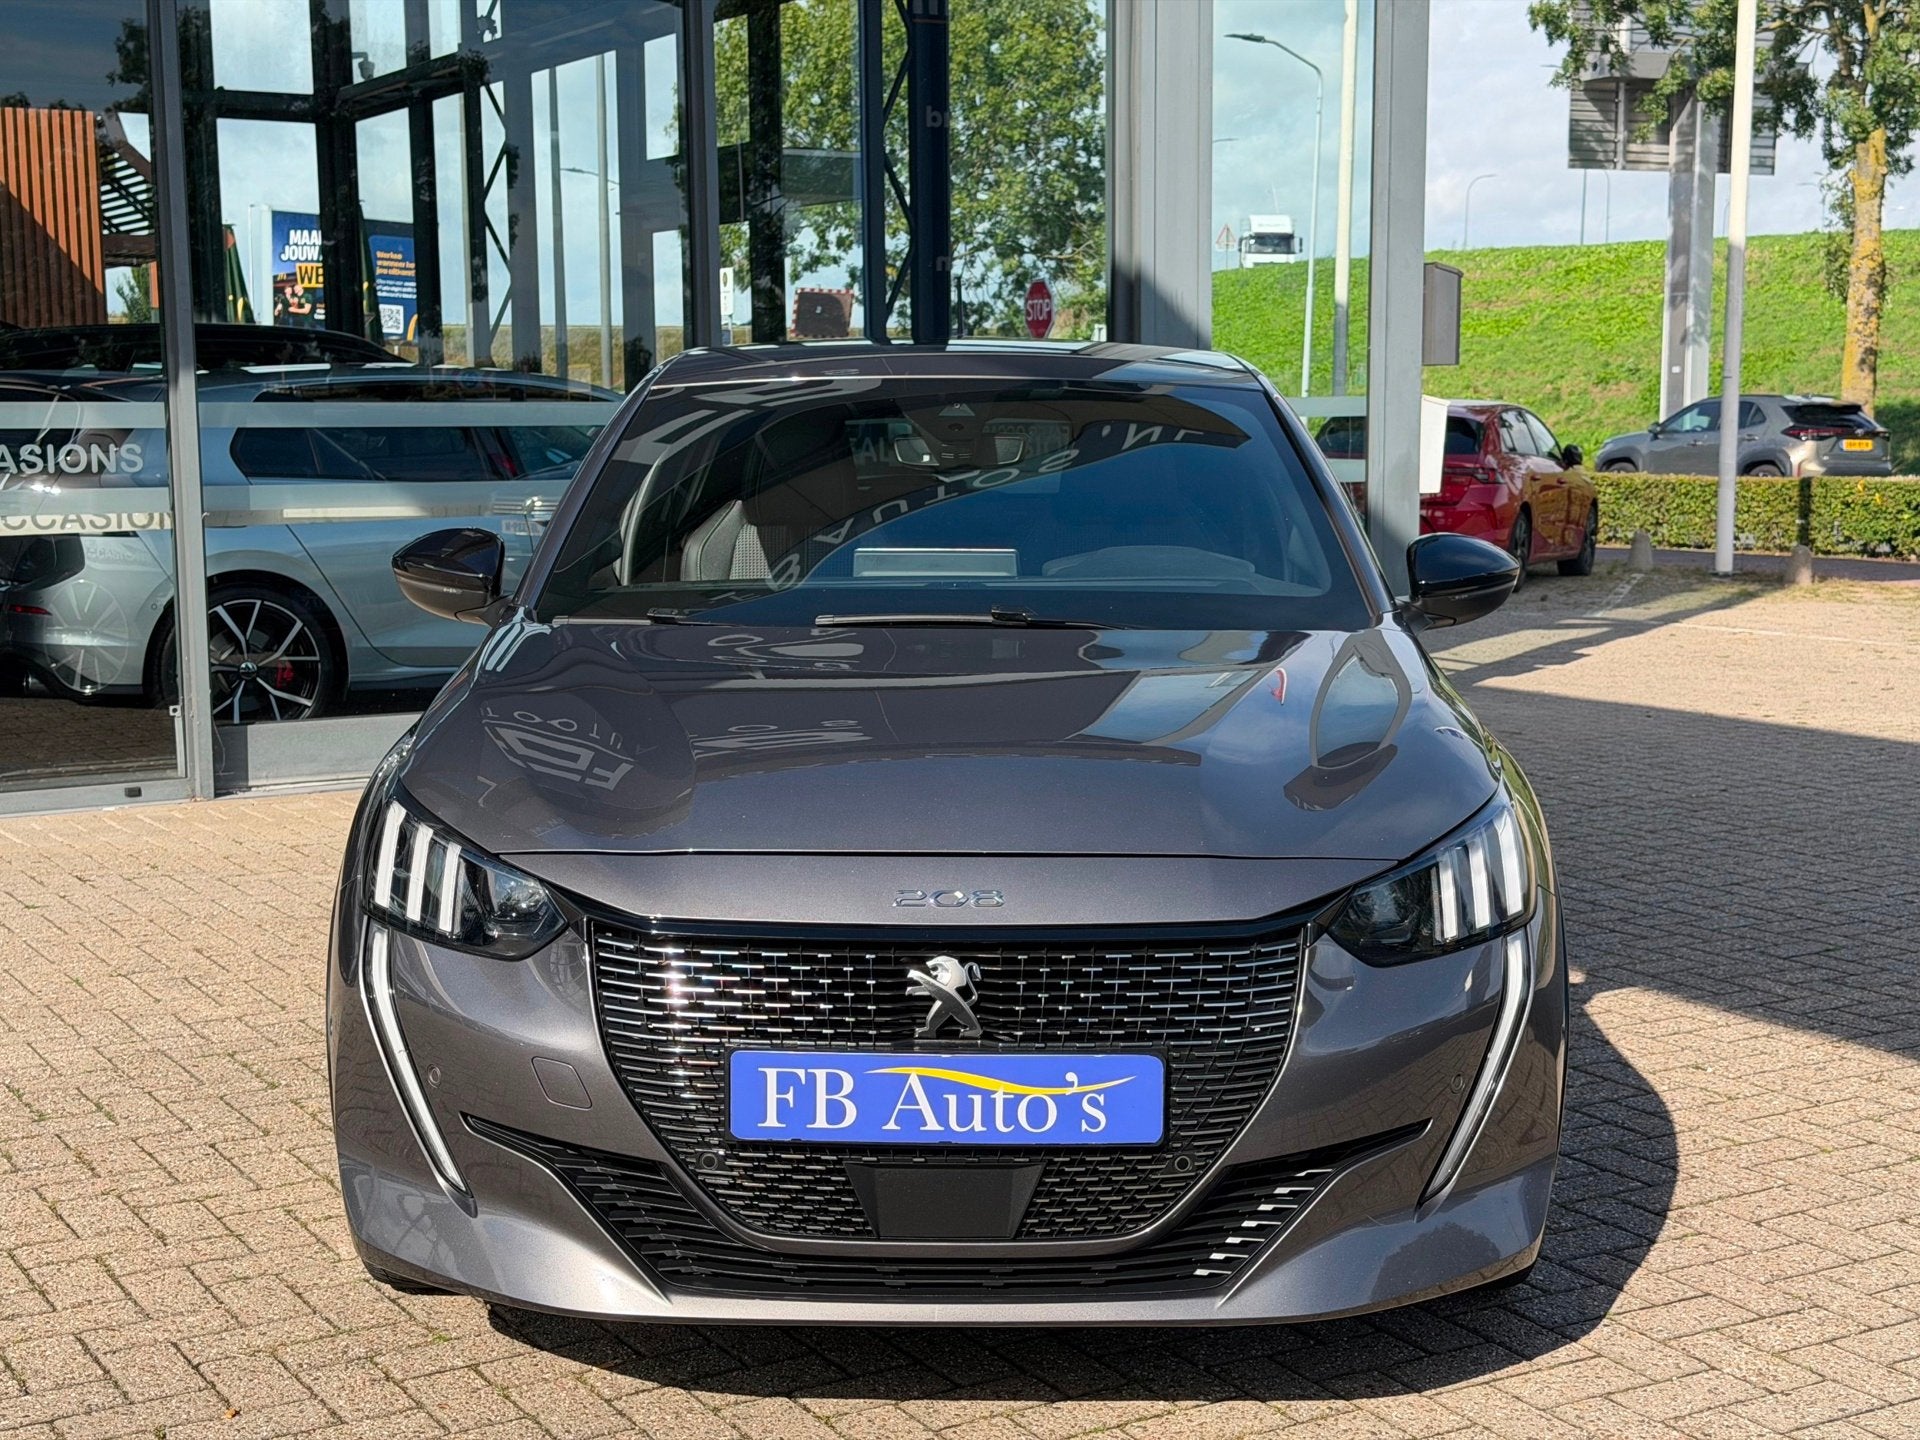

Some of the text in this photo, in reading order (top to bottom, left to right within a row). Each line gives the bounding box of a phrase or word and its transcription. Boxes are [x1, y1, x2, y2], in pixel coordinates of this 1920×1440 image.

[280, 245, 320, 261] JOUW
[1027, 299, 1051, 321] STOP
[891, 889, 1005, 908] 208
[757, 1067, 1108, 1133] FB Auto's
